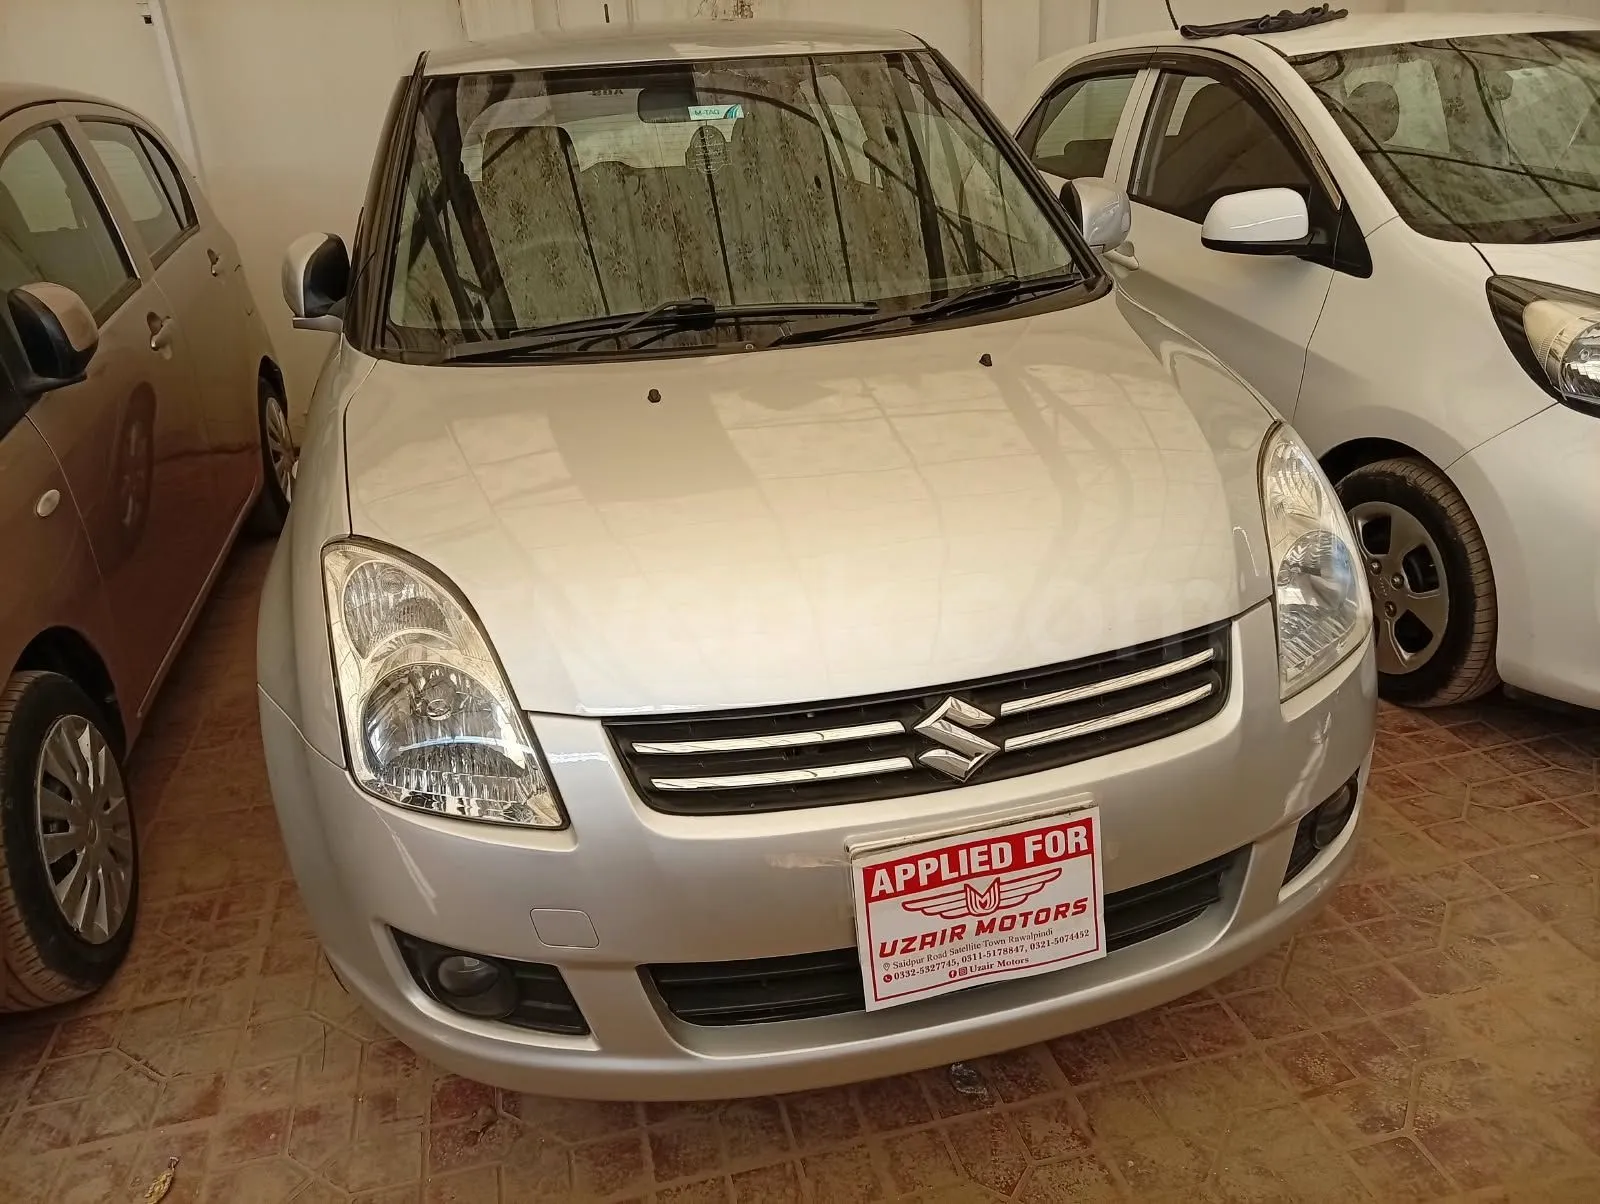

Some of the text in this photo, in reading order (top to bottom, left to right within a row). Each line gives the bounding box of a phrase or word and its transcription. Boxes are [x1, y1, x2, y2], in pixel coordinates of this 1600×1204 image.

[870, 825, 1089, 898] APPLIED FOR
[878, 896, 1089, 959] UZAIR MOTORS
[892, 927, 1054, 970] Saidpur Road Satellite Town Rawalpindi
[1029, 928, 1090, 951] 0321-5074452
[969, 957, 1030, 973] Uzair Motors
